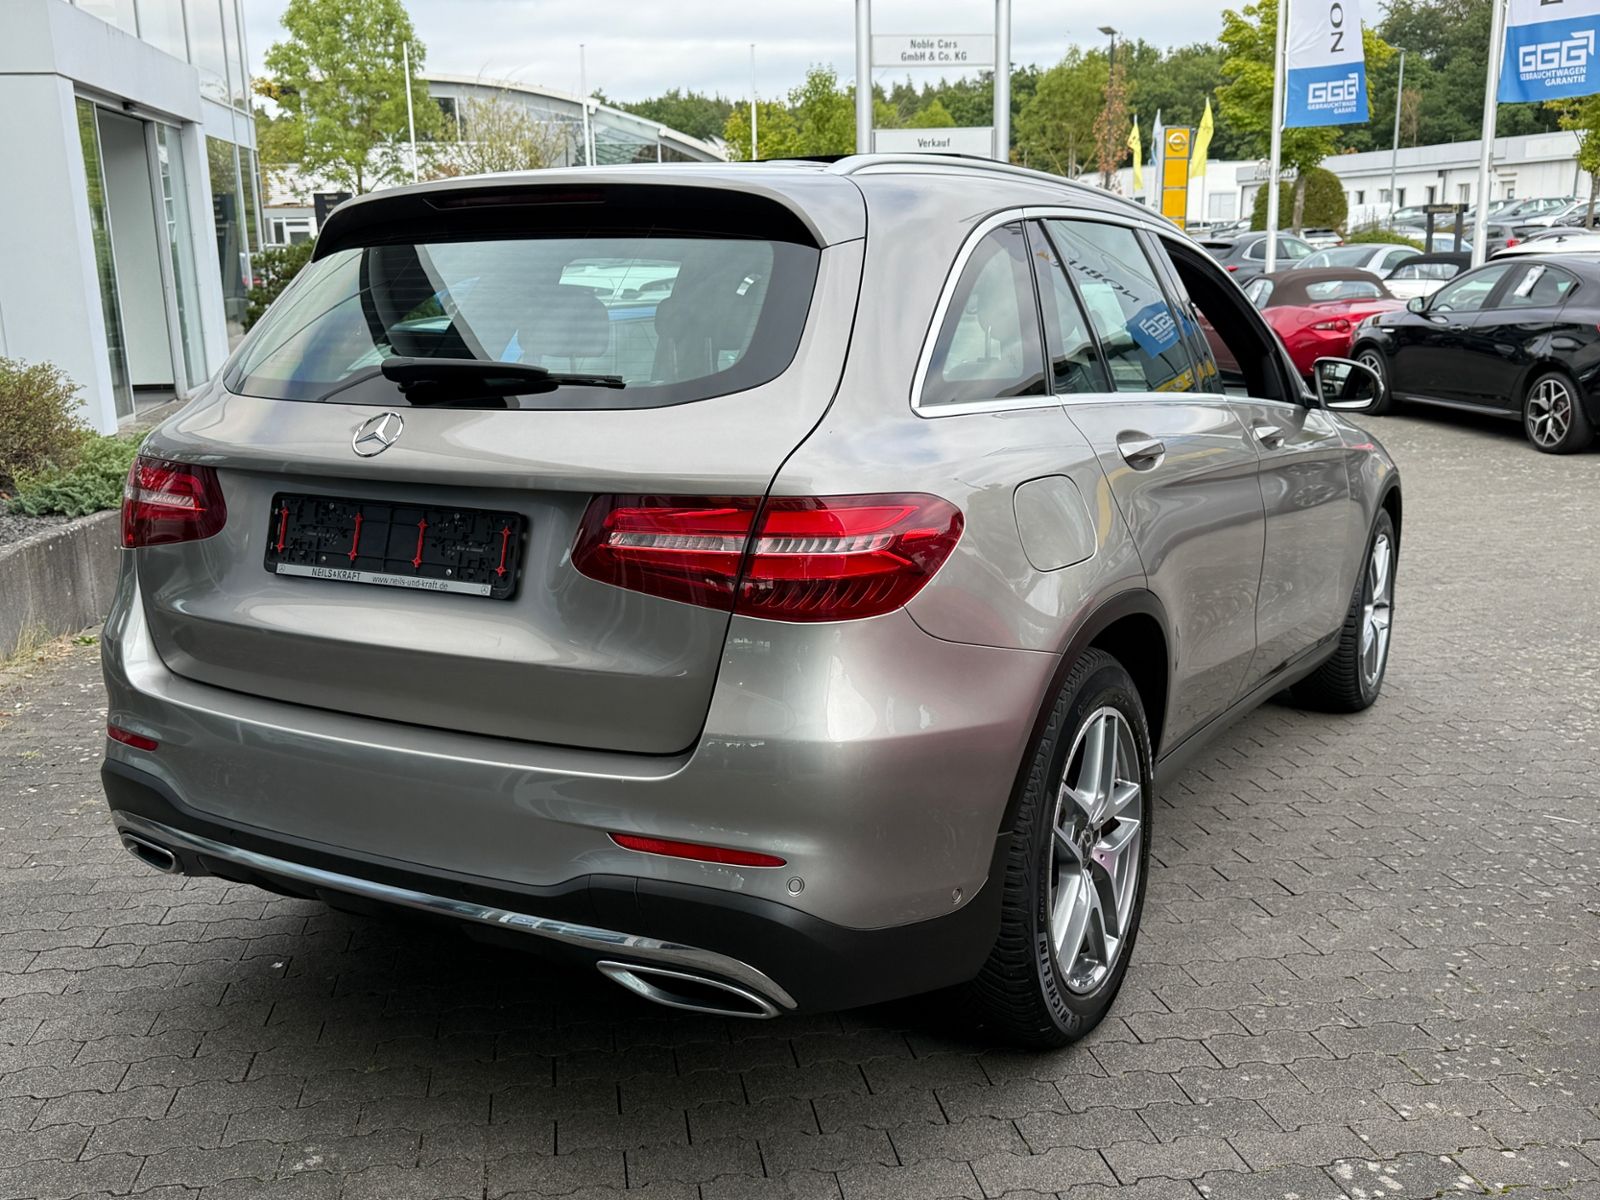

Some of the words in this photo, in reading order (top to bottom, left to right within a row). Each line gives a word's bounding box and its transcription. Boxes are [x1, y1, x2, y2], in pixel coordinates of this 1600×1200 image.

[910, 39, 935, 49] Noble
[937, 39, 958, 49] Cars
[901, 51, 926, 61] GmbH
[928, 51, 935, 61] &
[954, 51, 967, 61] KG
[1519, 38, 1588, 72] GGG
[1520, 66, 1587, 80] GEBRAUCHTWAGEN
[1544, 75, 1587, 87] GARANTIE
[1308, 79, 1357, 103] GGG
[917, 138, 951, 148] Verkauf
[311, 567, 361, 581] NEILS&KRAFT
[372, 576, 449, 590] www.neils-und-kraft.de
[1039, 940, 1071, 1024] MICHELIN
